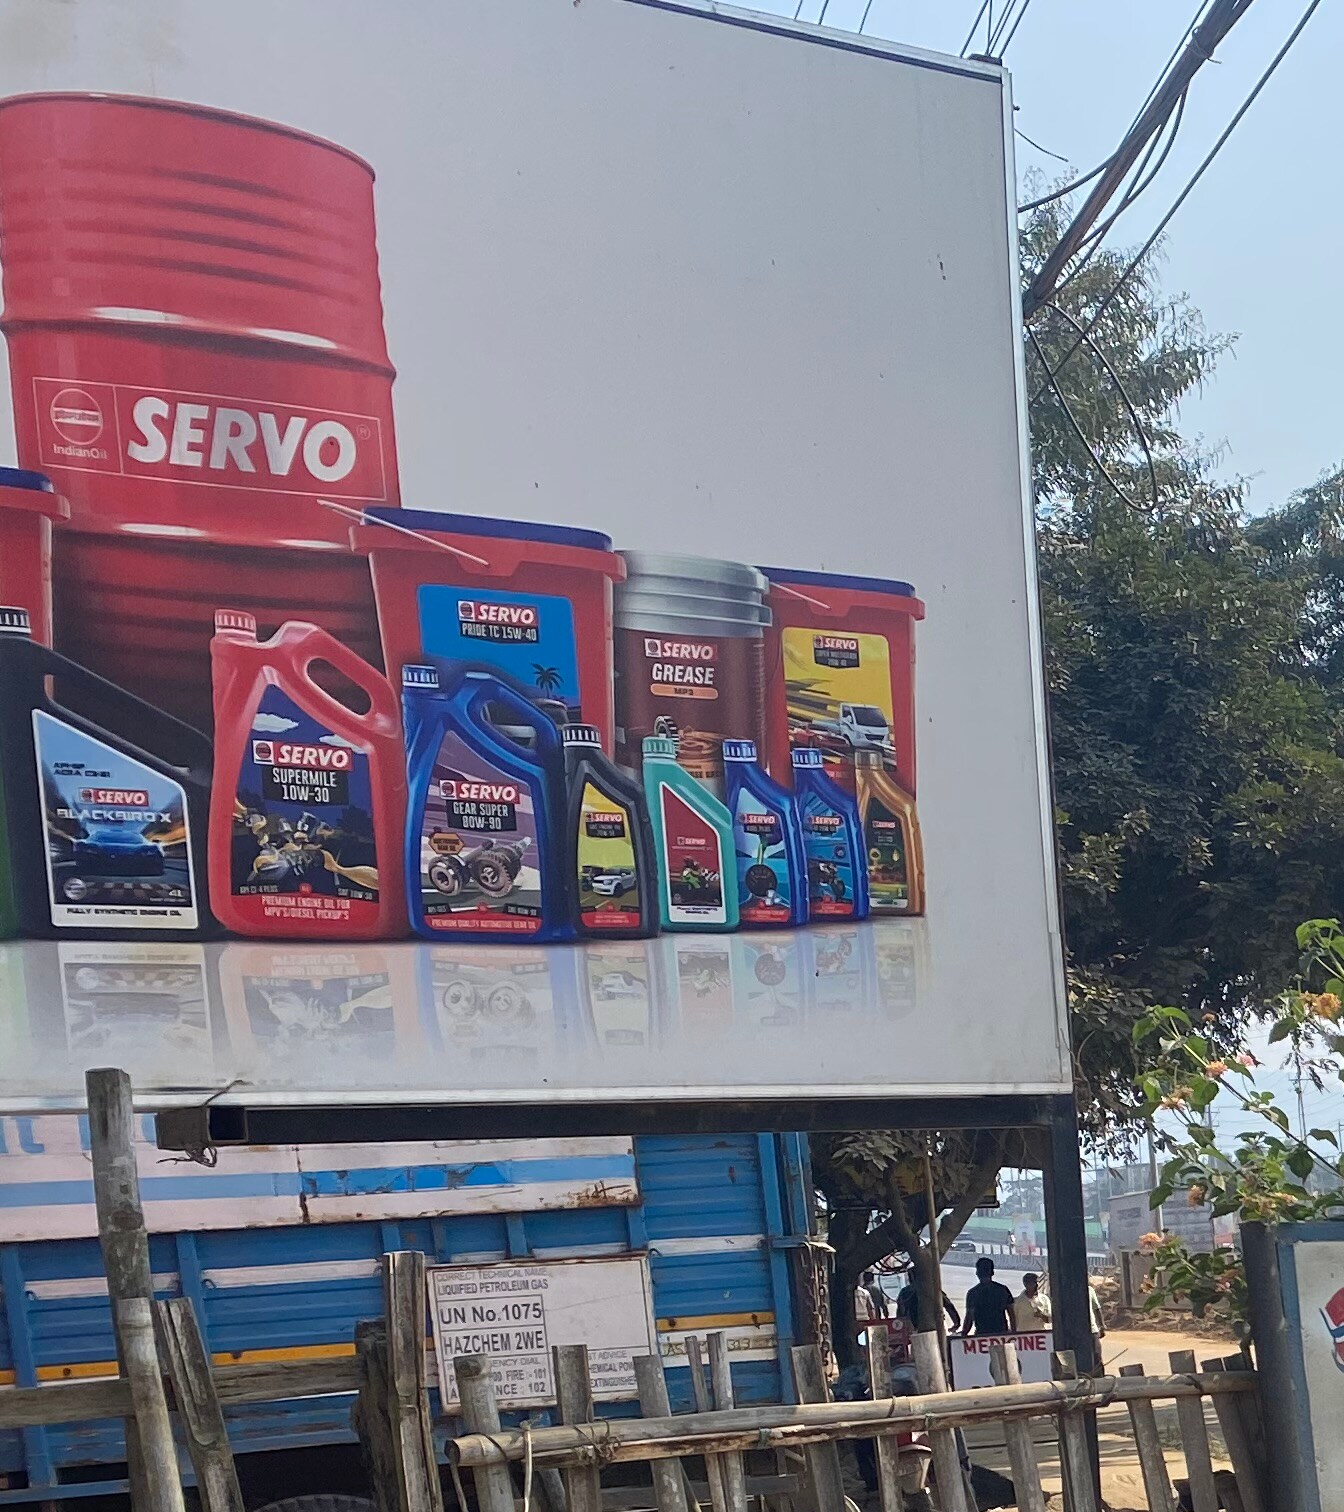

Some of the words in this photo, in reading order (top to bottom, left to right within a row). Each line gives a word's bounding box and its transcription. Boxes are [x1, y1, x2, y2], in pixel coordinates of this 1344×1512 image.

[127, 396, 357, 482] SERVO
[478, 604, 534, 624] SERVO
[462, 623, 487, 637] PRIDE
[489, 625, 500, 638] TC
[502, 626, 537, 641] 15W-40
[662, 642, 713, 660] SERVO
[824, 638, 857, 650] SERVO
[652, 663, 715, 685] GREASE
[278, 745, 349, 768] SERVO
[273, 767, 337, 787] SUPERMILE
[98, 790, 146, 805] SERVO
[282, 785, 329, 803] 10W-30
[459, 784, 516, 801] SERVO
[57, 809, 156, 823] BLACKBIRD
[157, 812, 172, 823] X
[453, 802, 477, 815] GEAR
[480, 803, 508, 817] SUPER
[595, 813, 622, 822] SERVO
[749, 815, 776, 824] SERVO
[814, 817, 840, 825] SERVO
[436, 1271, 475, 1281] CORRECT
[479, 1269, 523, 1280] TECHNICAL
[480, 1280, 529, 1293] PETROLEUM
[531, 1279, 549, 1289] GAS
[441, 1307, 466, 1324] UN
[443, 1333, 511, 1354] HAZCHEM
[515, 1331, 545, 1350] 2WE
[506, 1370, 524, 1381] FIRE
[529, 1382, 546, 1393] 102
